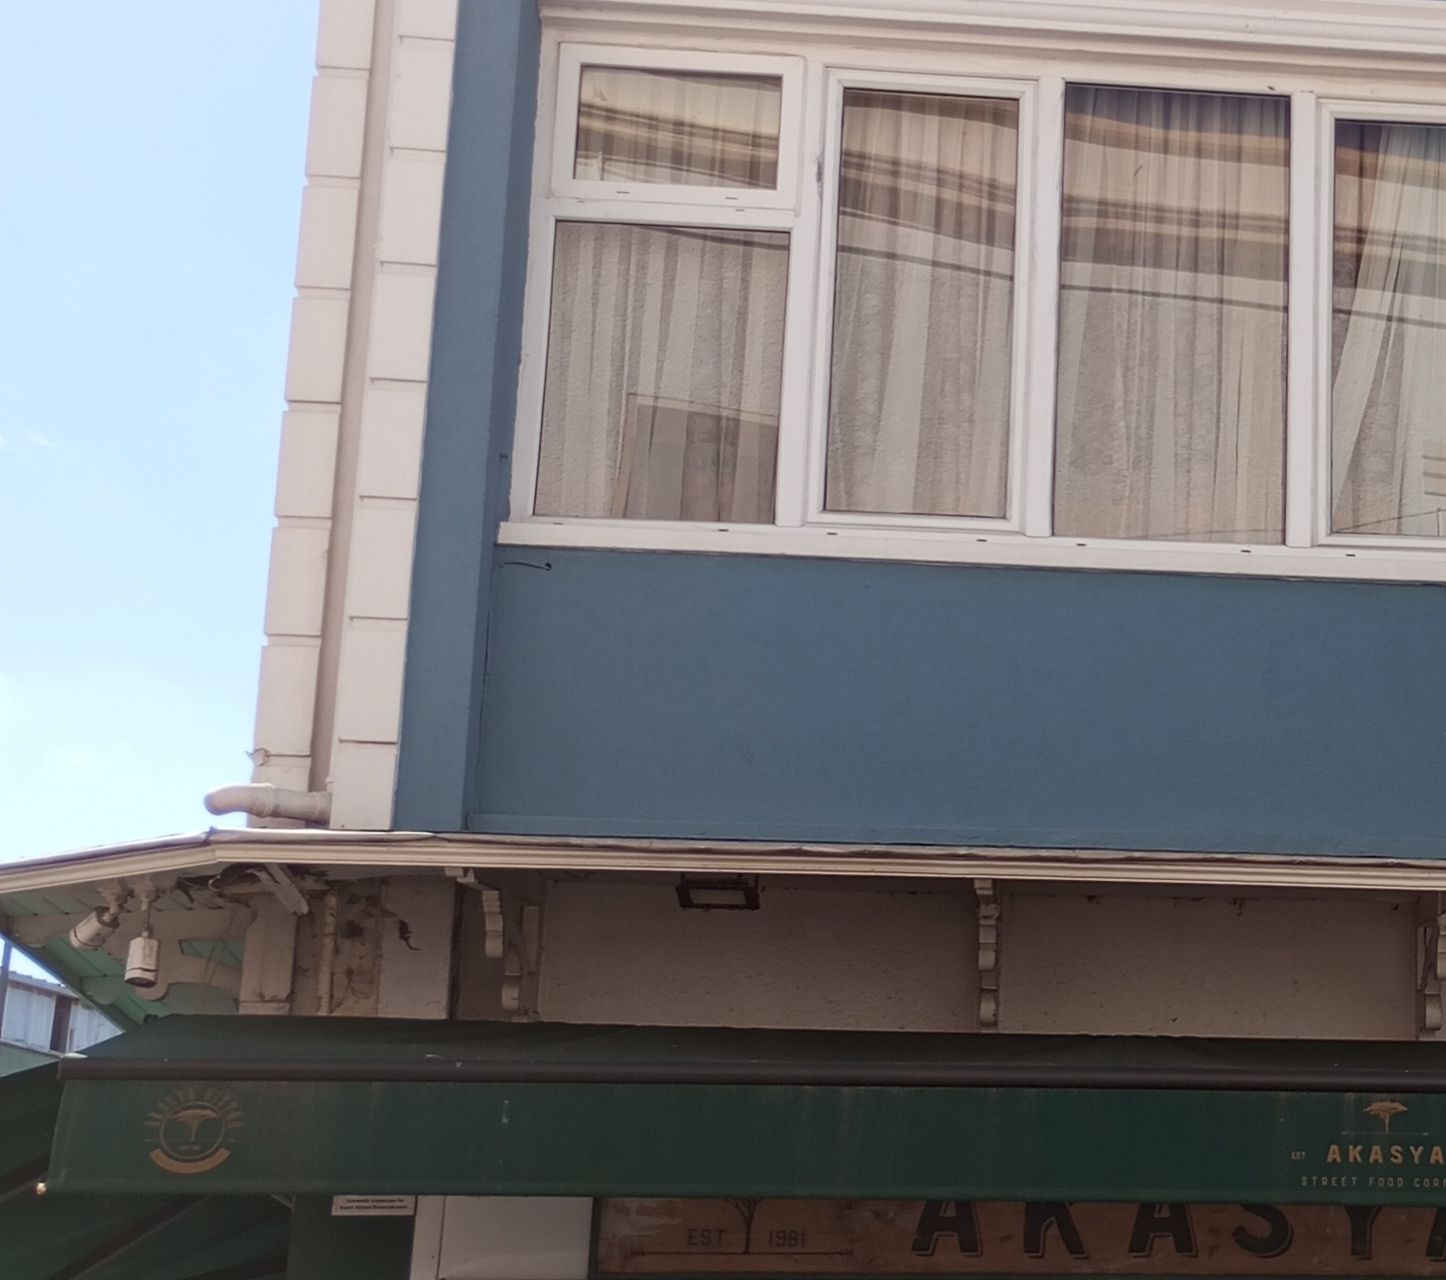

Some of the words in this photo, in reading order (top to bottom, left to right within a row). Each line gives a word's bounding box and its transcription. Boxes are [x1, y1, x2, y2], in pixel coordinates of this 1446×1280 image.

[1326, 1143, 1446, 1166] AKASYA
[1300, 1175, 1358, 1187] STREET
[1368, 1176, 1404, 1188] FOOD
[687, 1227, 727, 1248] EST
[768, 1228, 807, 1248] 1981
